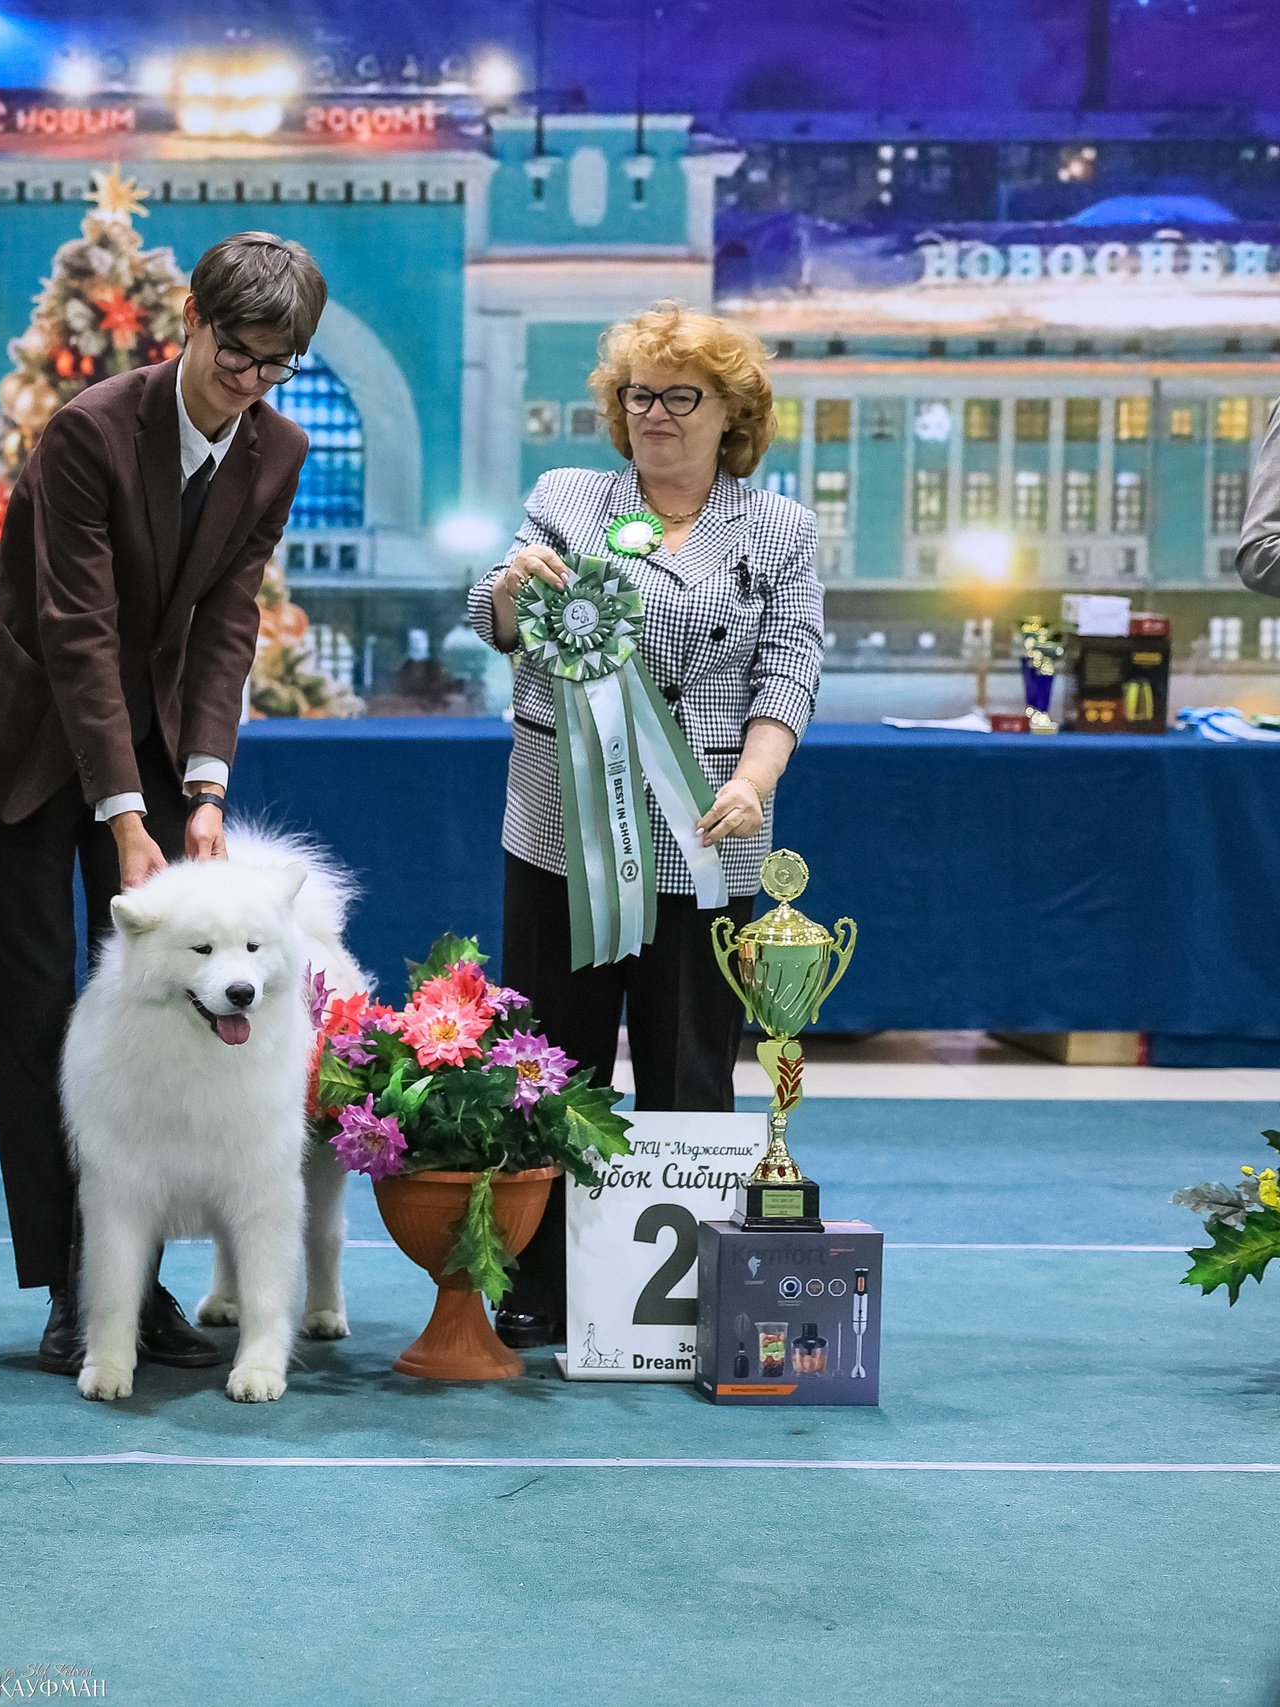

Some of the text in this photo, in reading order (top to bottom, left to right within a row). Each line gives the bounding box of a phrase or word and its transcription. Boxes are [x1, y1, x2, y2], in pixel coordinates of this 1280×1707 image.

[613, 778, 624, 805] BEST
[616, 806, 626, 820] IN
[619, 822, 633, 855] SHOW
[626, 865, 634, 877] 2
[632, 1203, 698, 1326] 2
[633, 1354, 696, 1370] Dream
